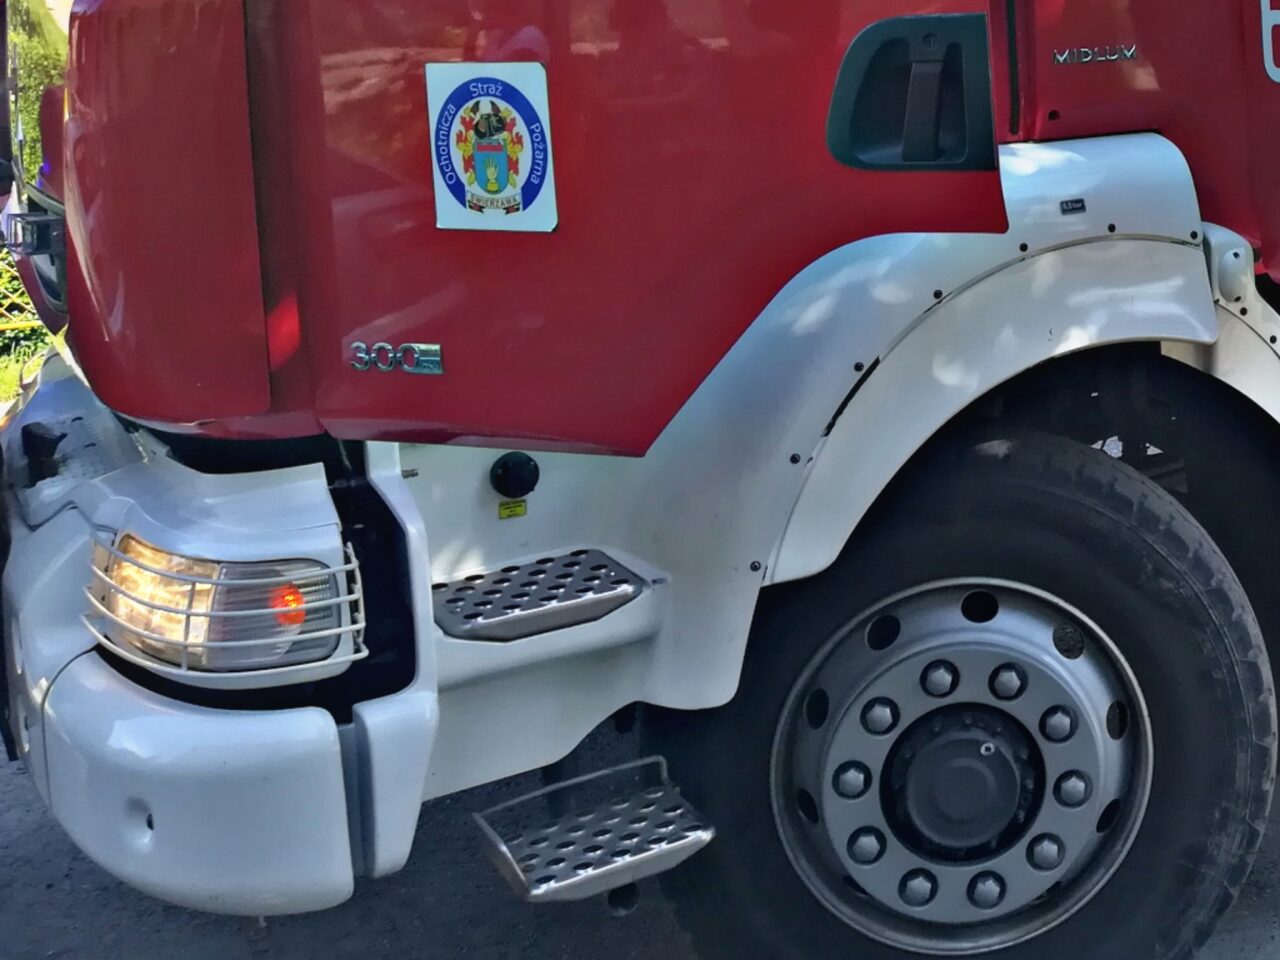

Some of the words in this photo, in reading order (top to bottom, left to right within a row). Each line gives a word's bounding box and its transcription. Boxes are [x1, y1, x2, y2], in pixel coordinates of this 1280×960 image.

[1053, 43, 1136, 65] MIDLUM
[437, 104, 456, 185] Ochotnicza
[469, 82, 503, 97] Straż
[530, 122, 546, 185] Pożarna
[350, 341, 420, 373] 300
